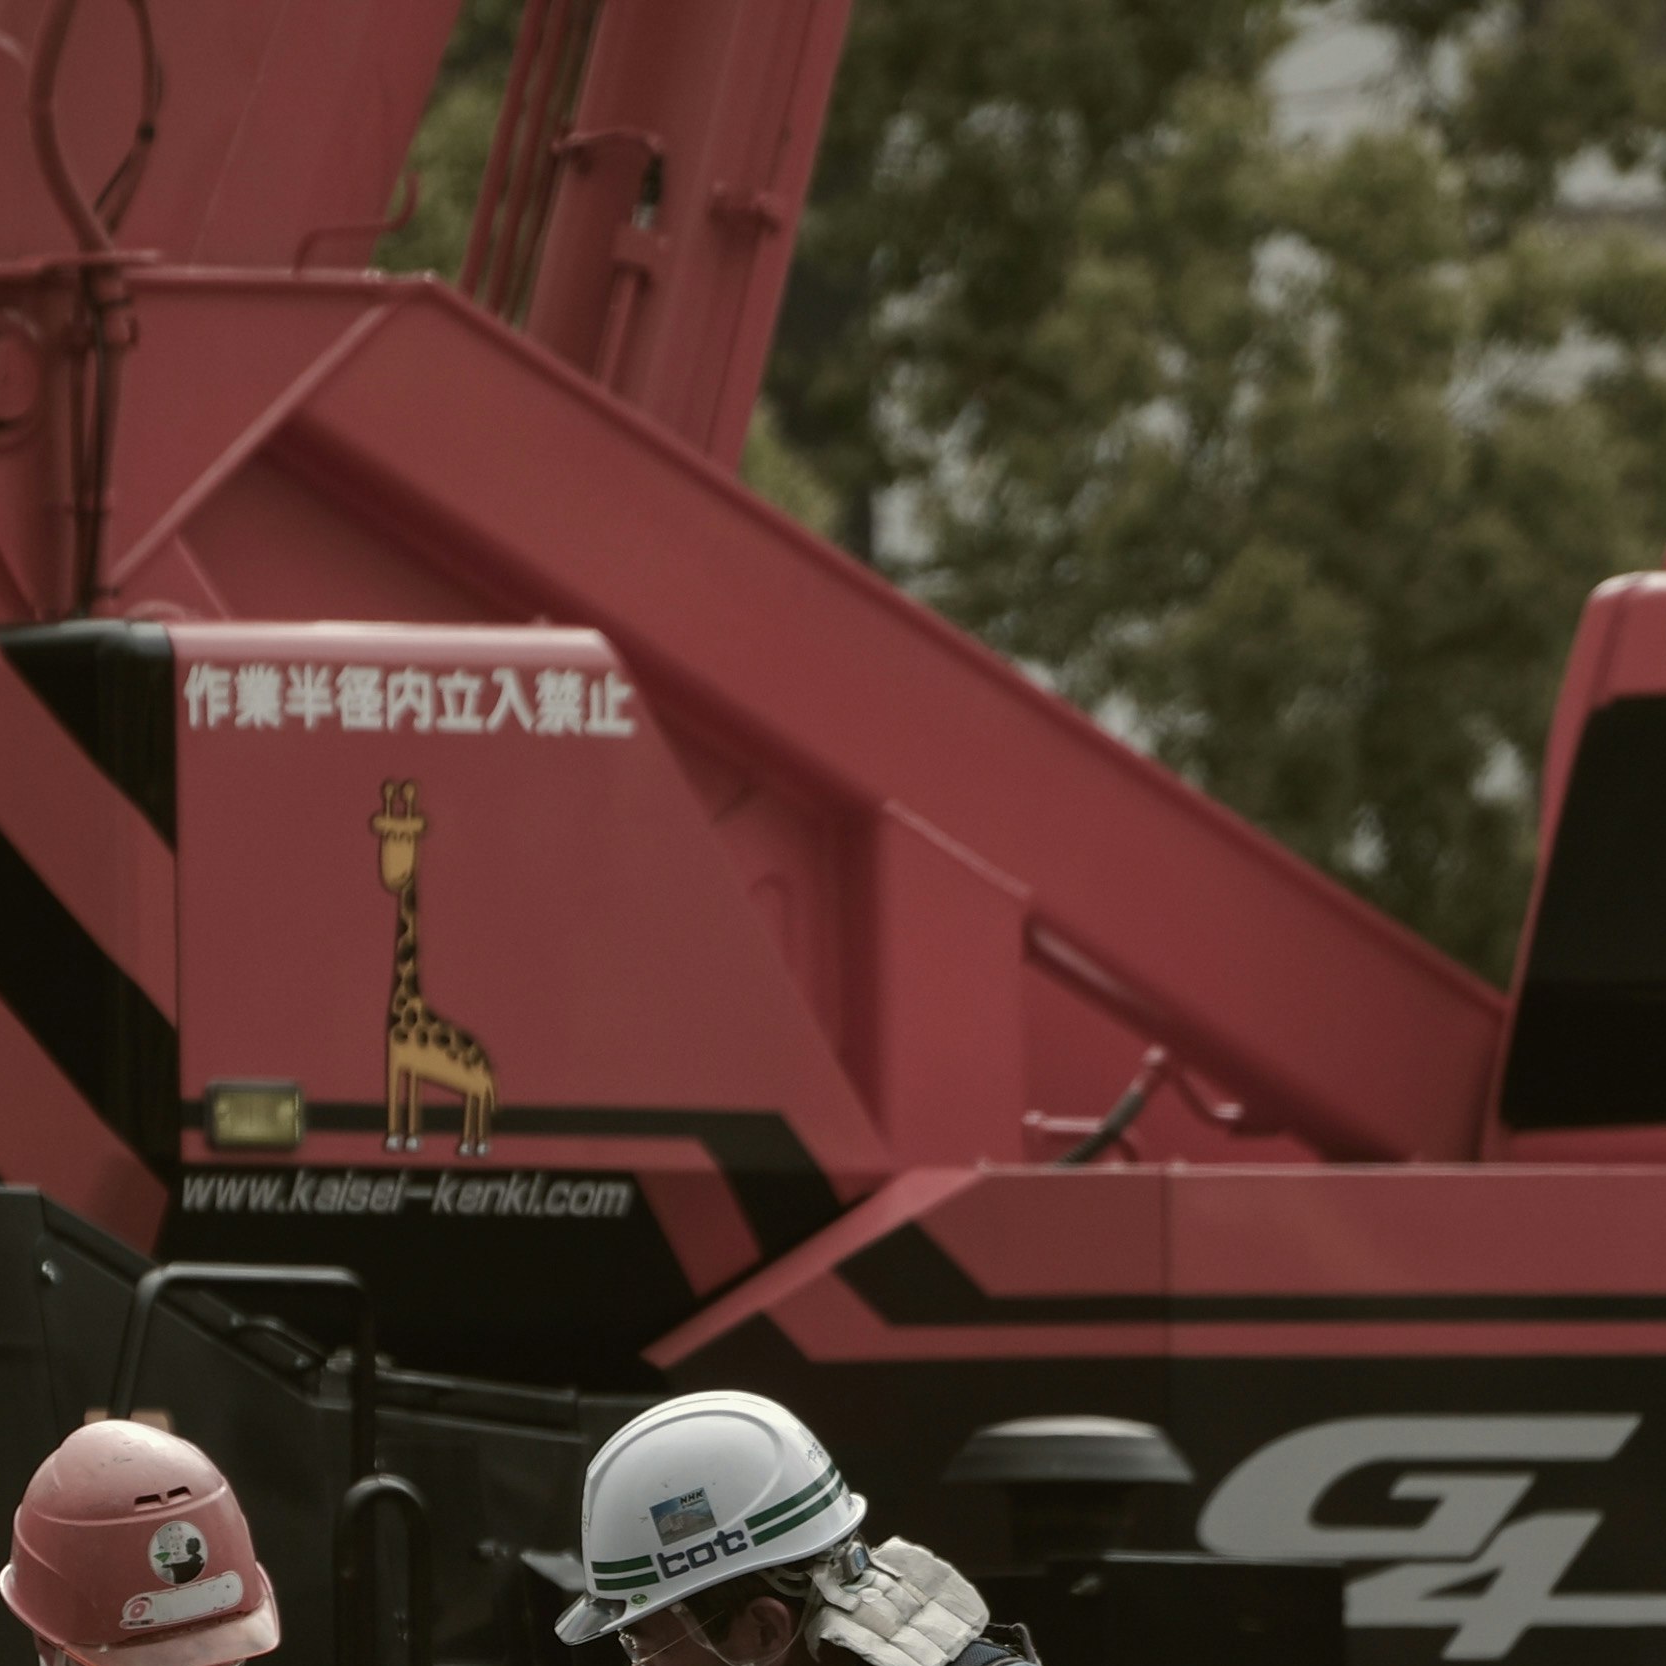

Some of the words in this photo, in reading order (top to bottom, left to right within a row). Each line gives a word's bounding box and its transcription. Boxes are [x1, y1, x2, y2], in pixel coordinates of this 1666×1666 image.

[183, 662, 634, 736] 作業半径内立入禁止
[181, 1167, 630, 1217] www.kaisei-kenki.com
[679, 1489, 703, 1505] NHK
